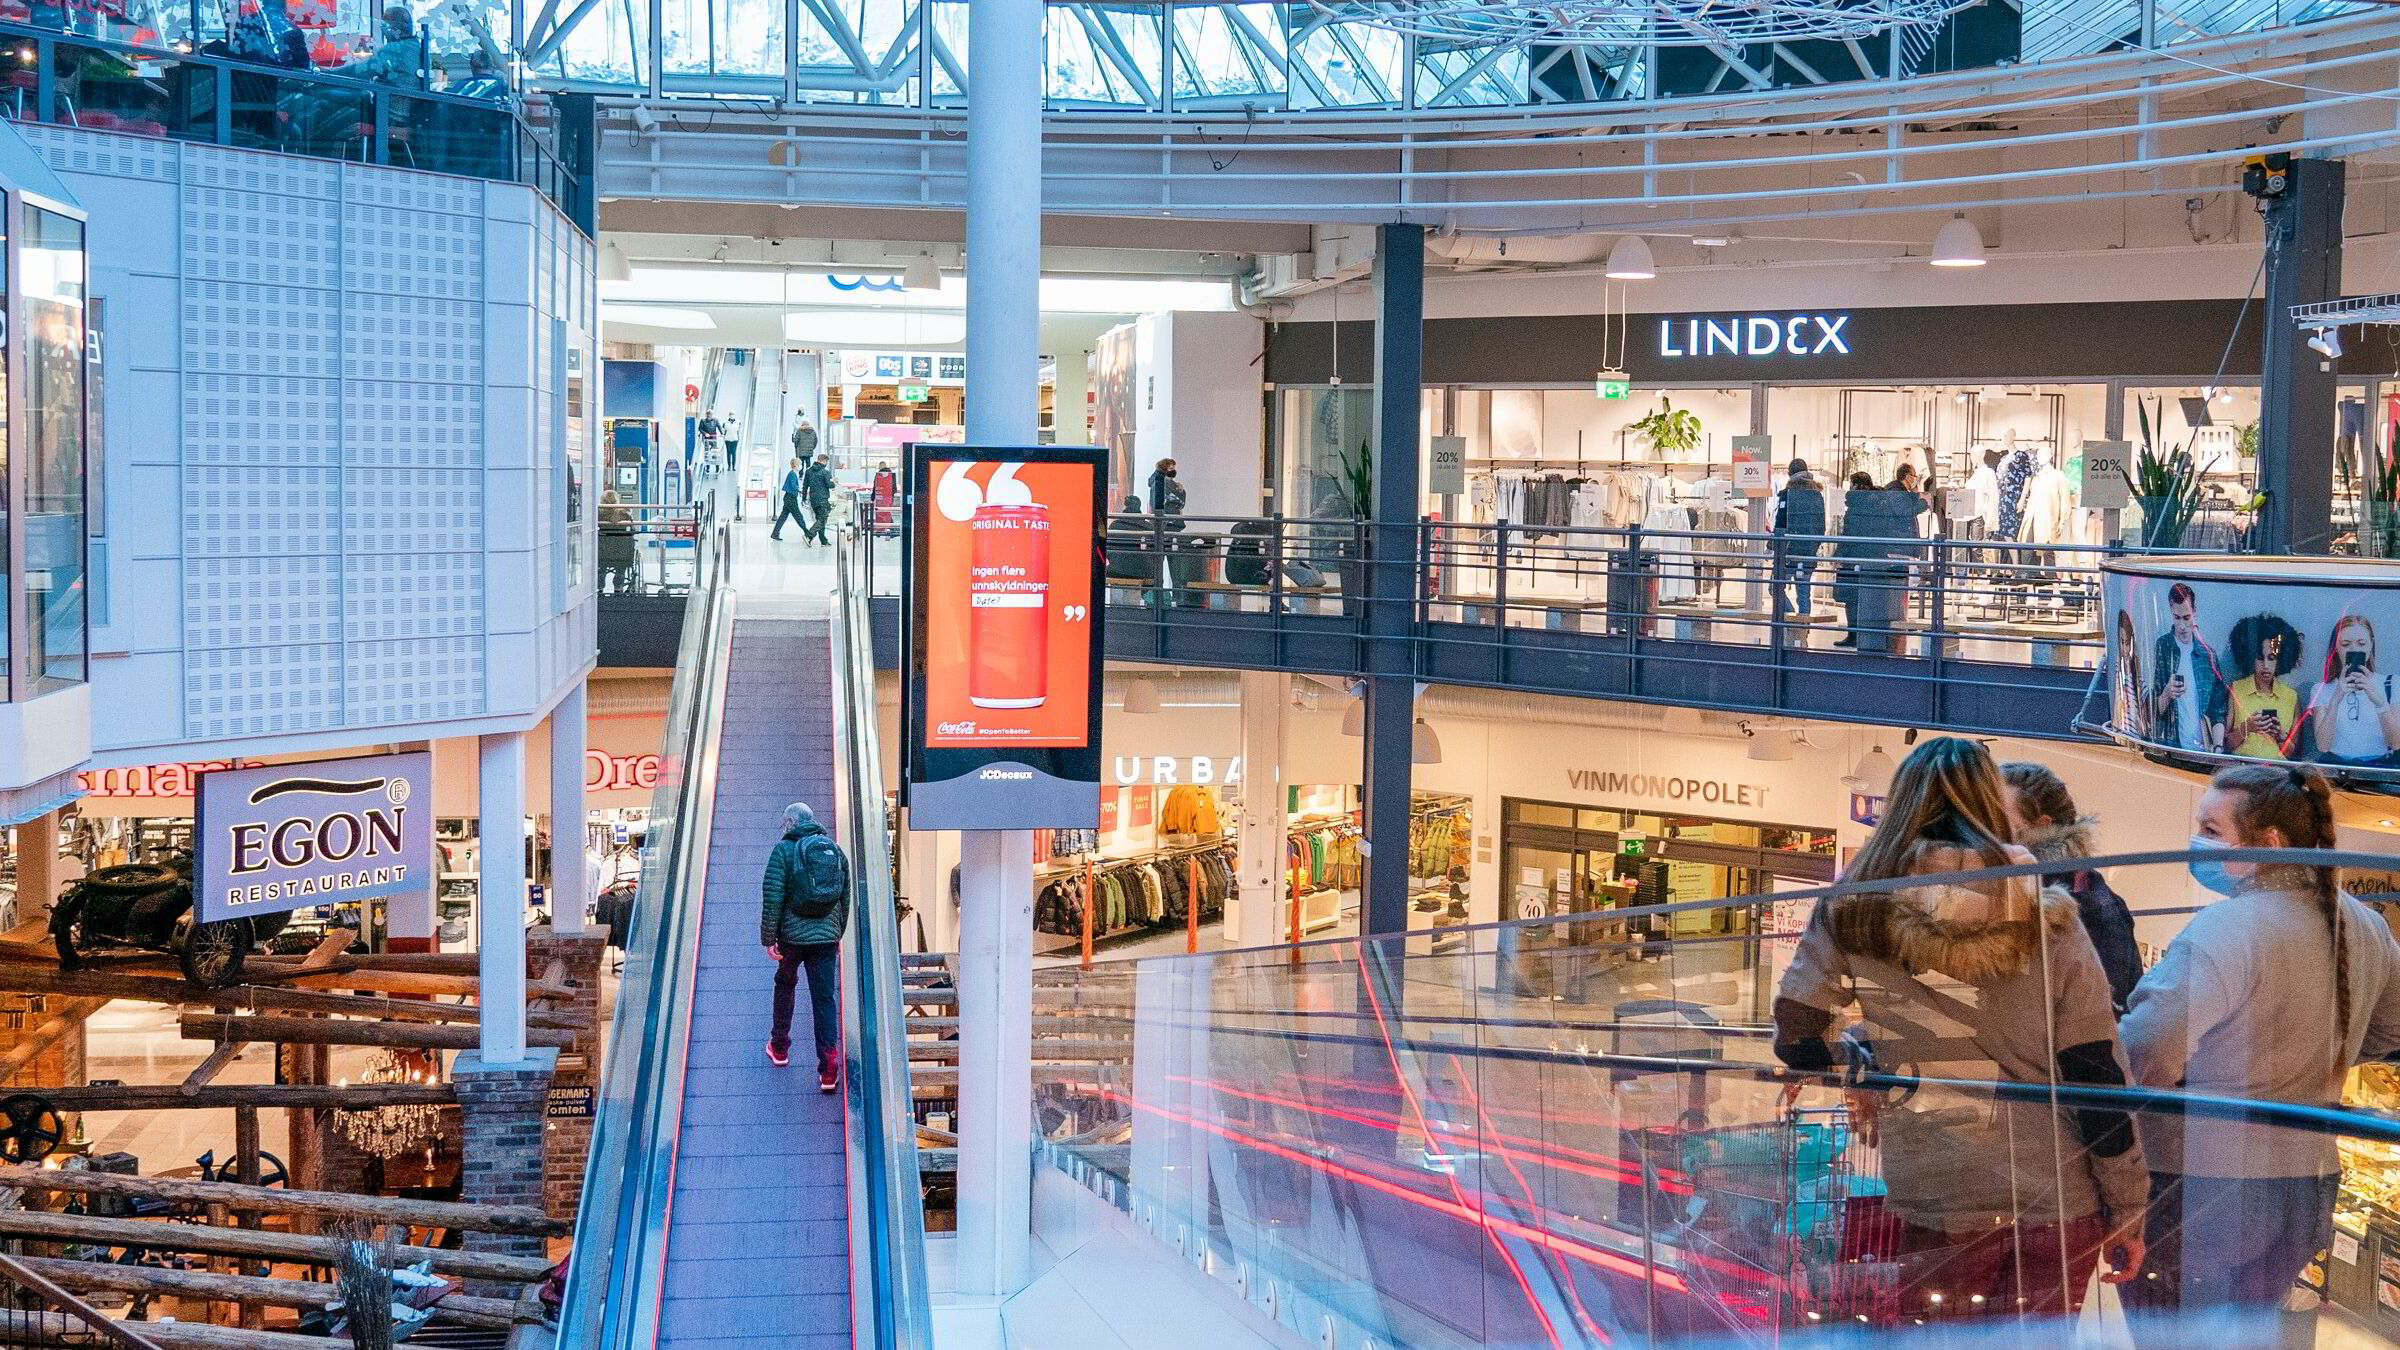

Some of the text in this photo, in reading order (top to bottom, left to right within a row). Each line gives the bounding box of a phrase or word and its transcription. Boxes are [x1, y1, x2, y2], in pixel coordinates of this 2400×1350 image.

[1661, 316, 1849, 356] LINDEX
[1436, 452, 1459, 463] 20%
[1744, 467, 1760, 475] 30%
[2091, 459, 2121, 471] 20%
[972, 519, 1020, 532] ORIGINAL
[972, 566, 1026, 577] Ingen flere
[979, 769, 1033, 780] JCDecaux
[1567, 769, 1769, 808] VINMONOPOLET
[230, 807, 405, 875] EGON
[227, 866, 407, 906] RESTAURANT
